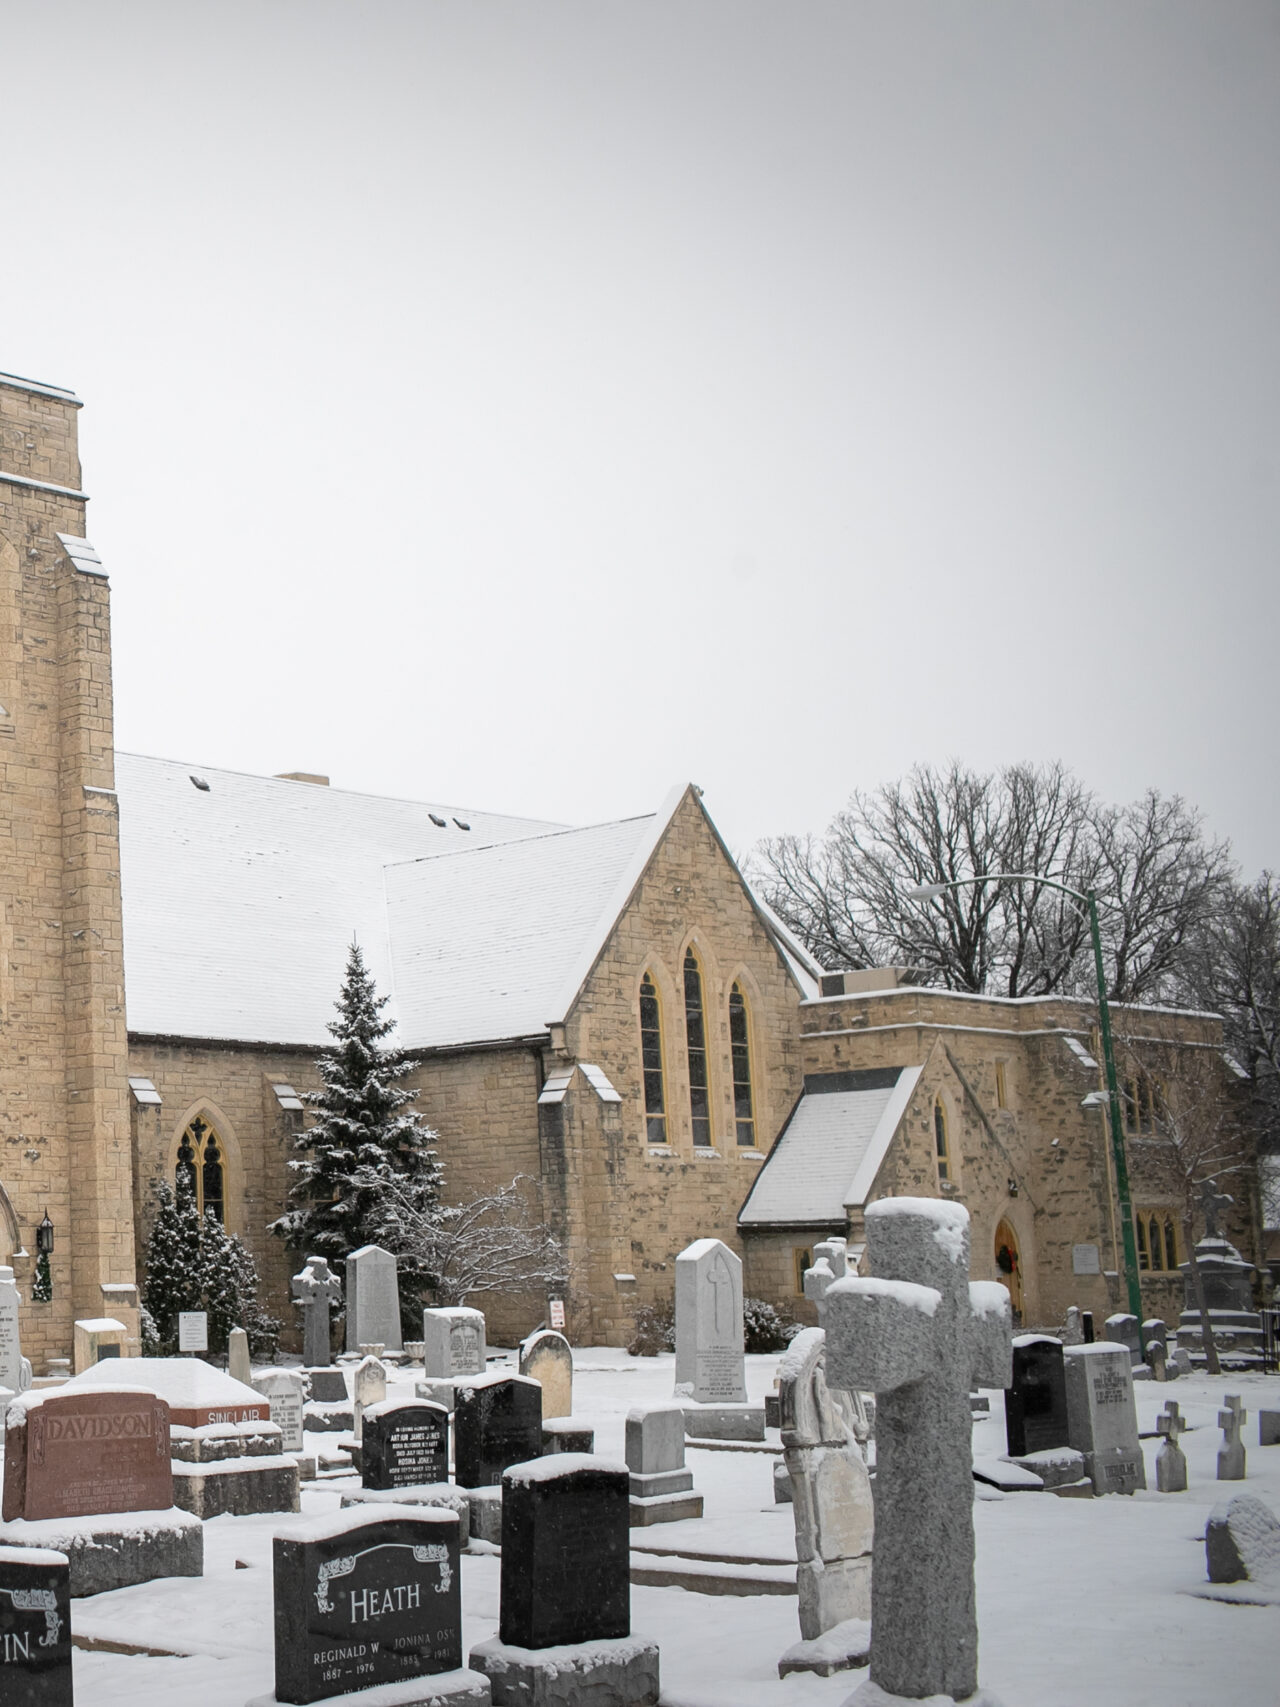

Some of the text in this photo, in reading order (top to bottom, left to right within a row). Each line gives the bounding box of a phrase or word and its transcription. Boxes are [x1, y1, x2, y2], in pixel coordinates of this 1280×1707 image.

[207, 1409, 260, 1425] SINCLAIR
[49, 1414, 151, 1440] DAVIDSON
[393, 1633, 431, 1650] JONINA
[313, 1641, 380, 1665] REGINALD W
[434, 1648, 450, 1660] 1981
[323, 1668, 341, 1682] 1887
[356, 1664, 375, 1675] 1976
